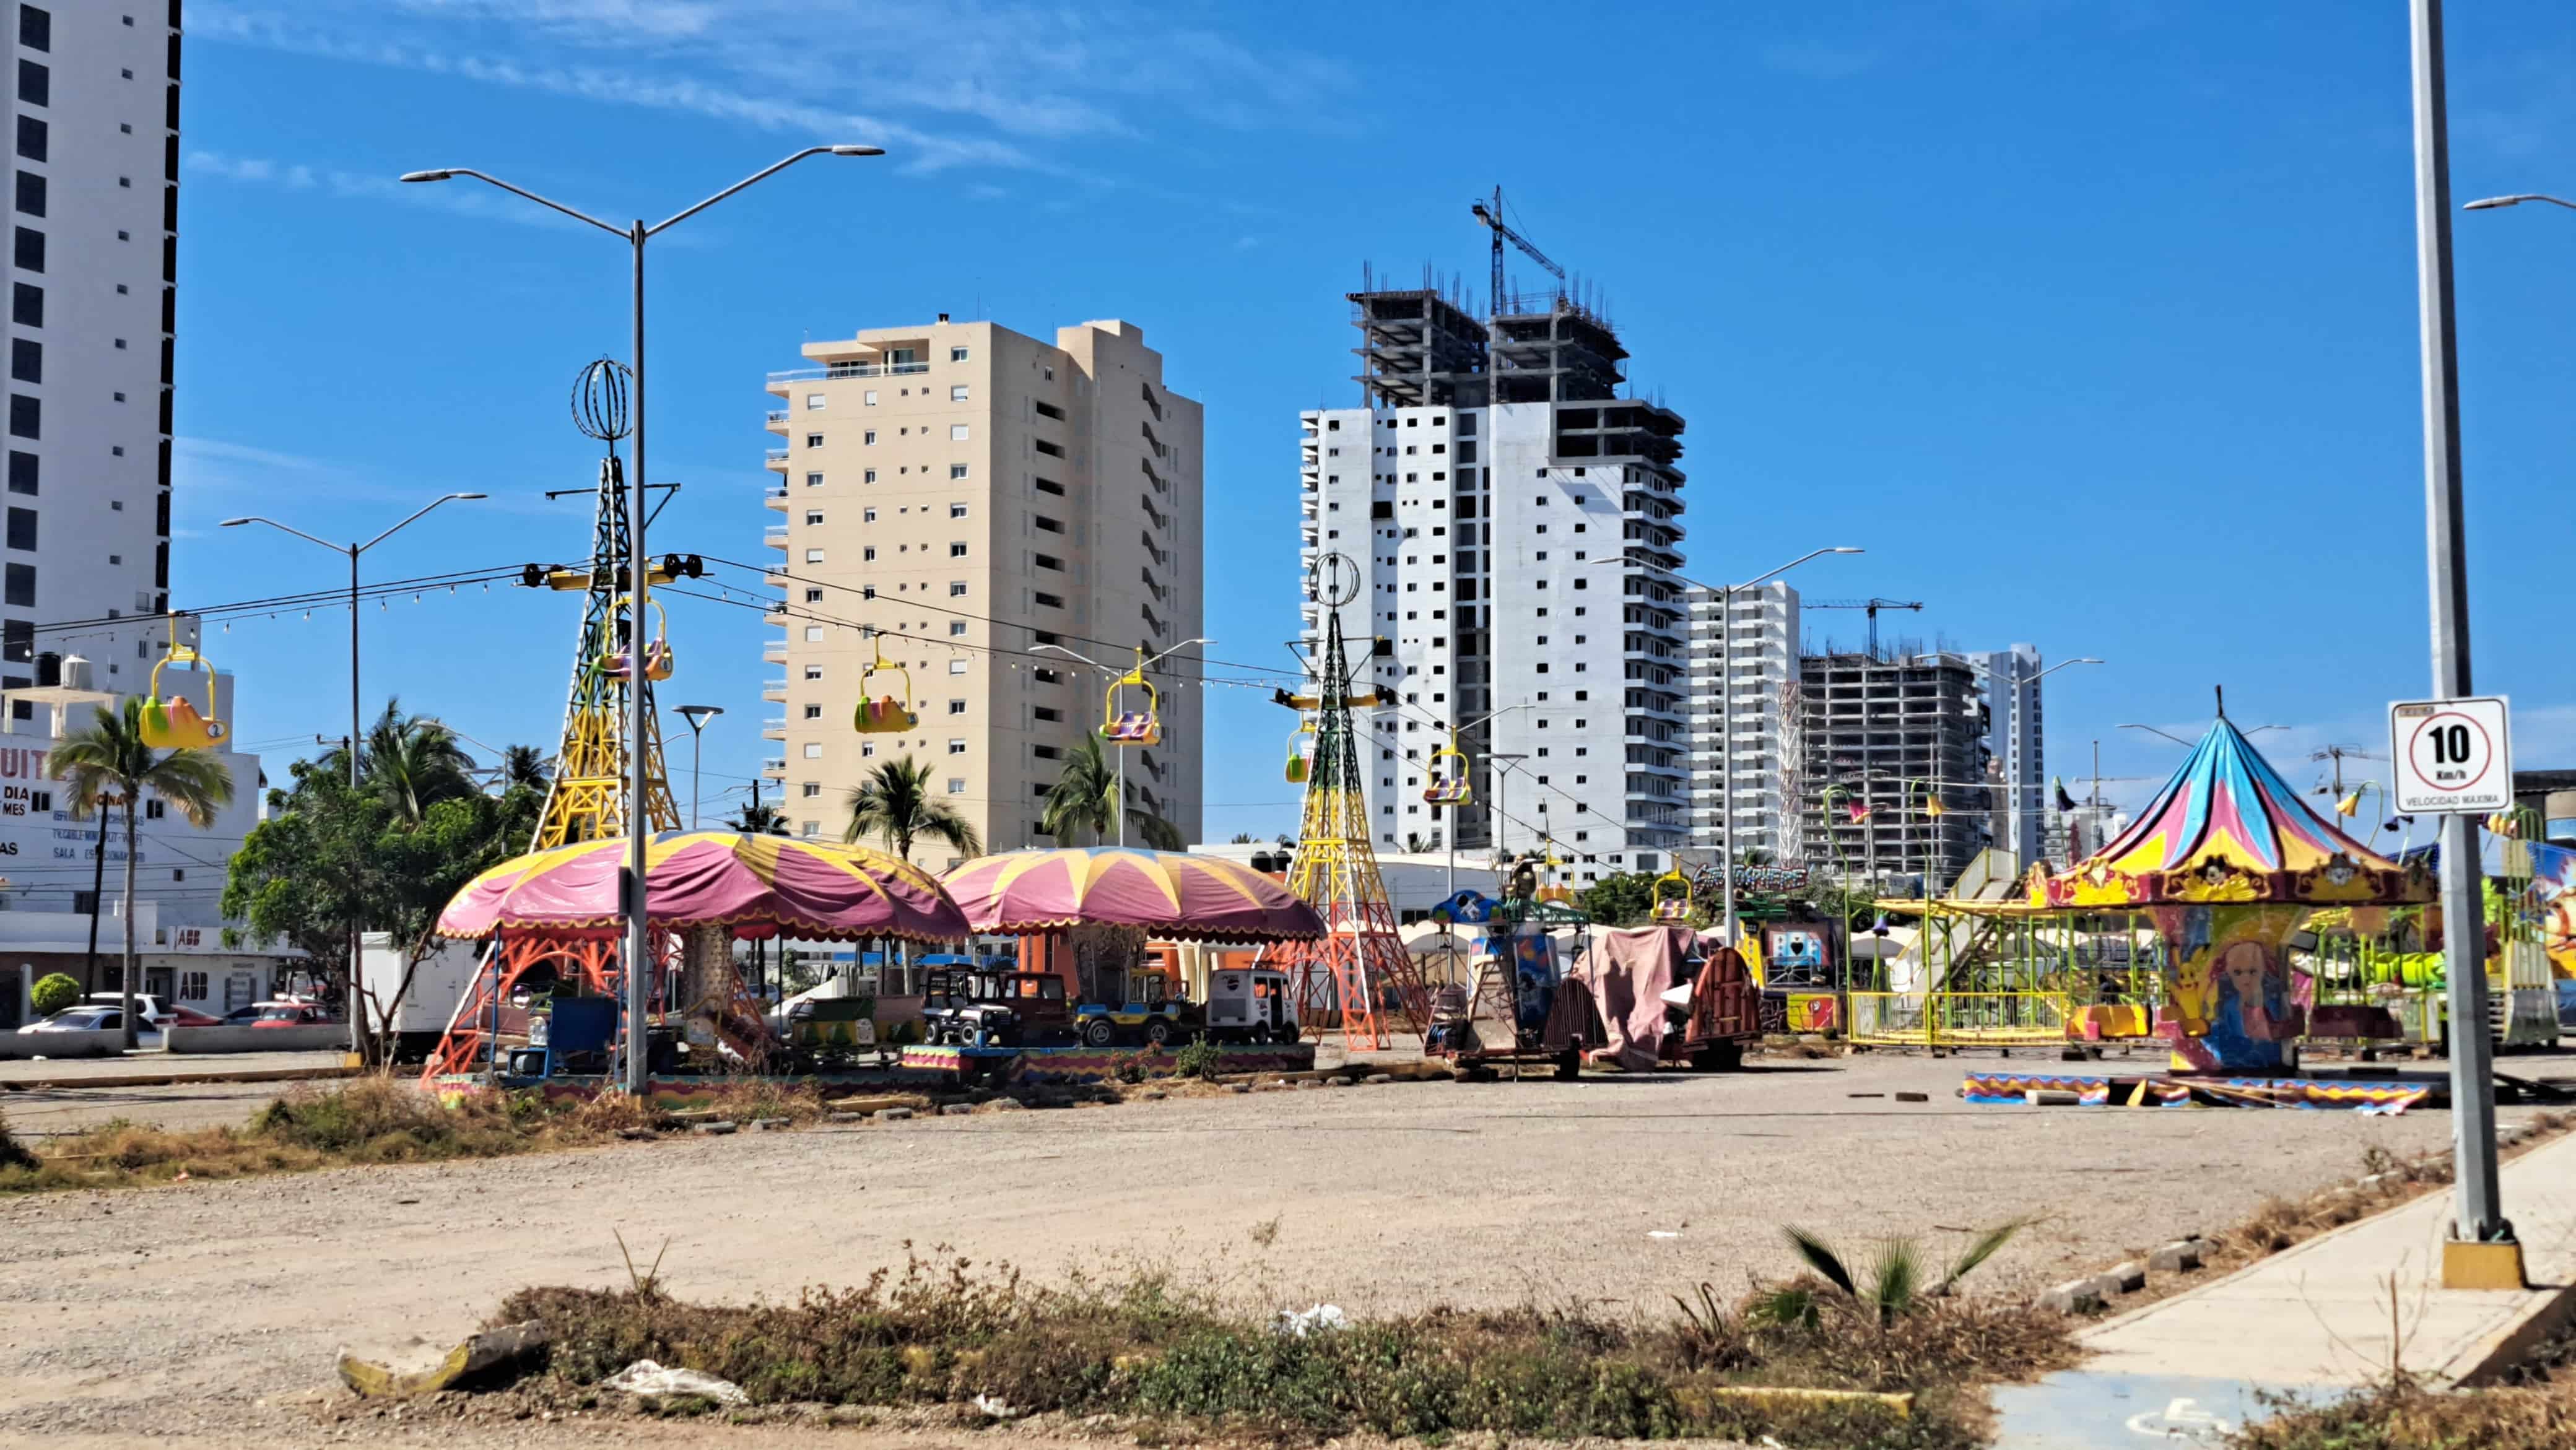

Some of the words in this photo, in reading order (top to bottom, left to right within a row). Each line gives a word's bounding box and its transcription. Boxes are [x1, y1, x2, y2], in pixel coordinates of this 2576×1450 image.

[2429, 724, 2470, 764] 10
[2436, 770, 2467, 780] Km/h
[4, 786, 29, 800] DIA
[2406, 796, 2459, 807] VELOCIDAD
[2, 802, 25, 816] MES
[53, 846, 75, 859] SALA
[178, 929, 200, 946] ABB
[179, 971, 208, 1001] ABB
